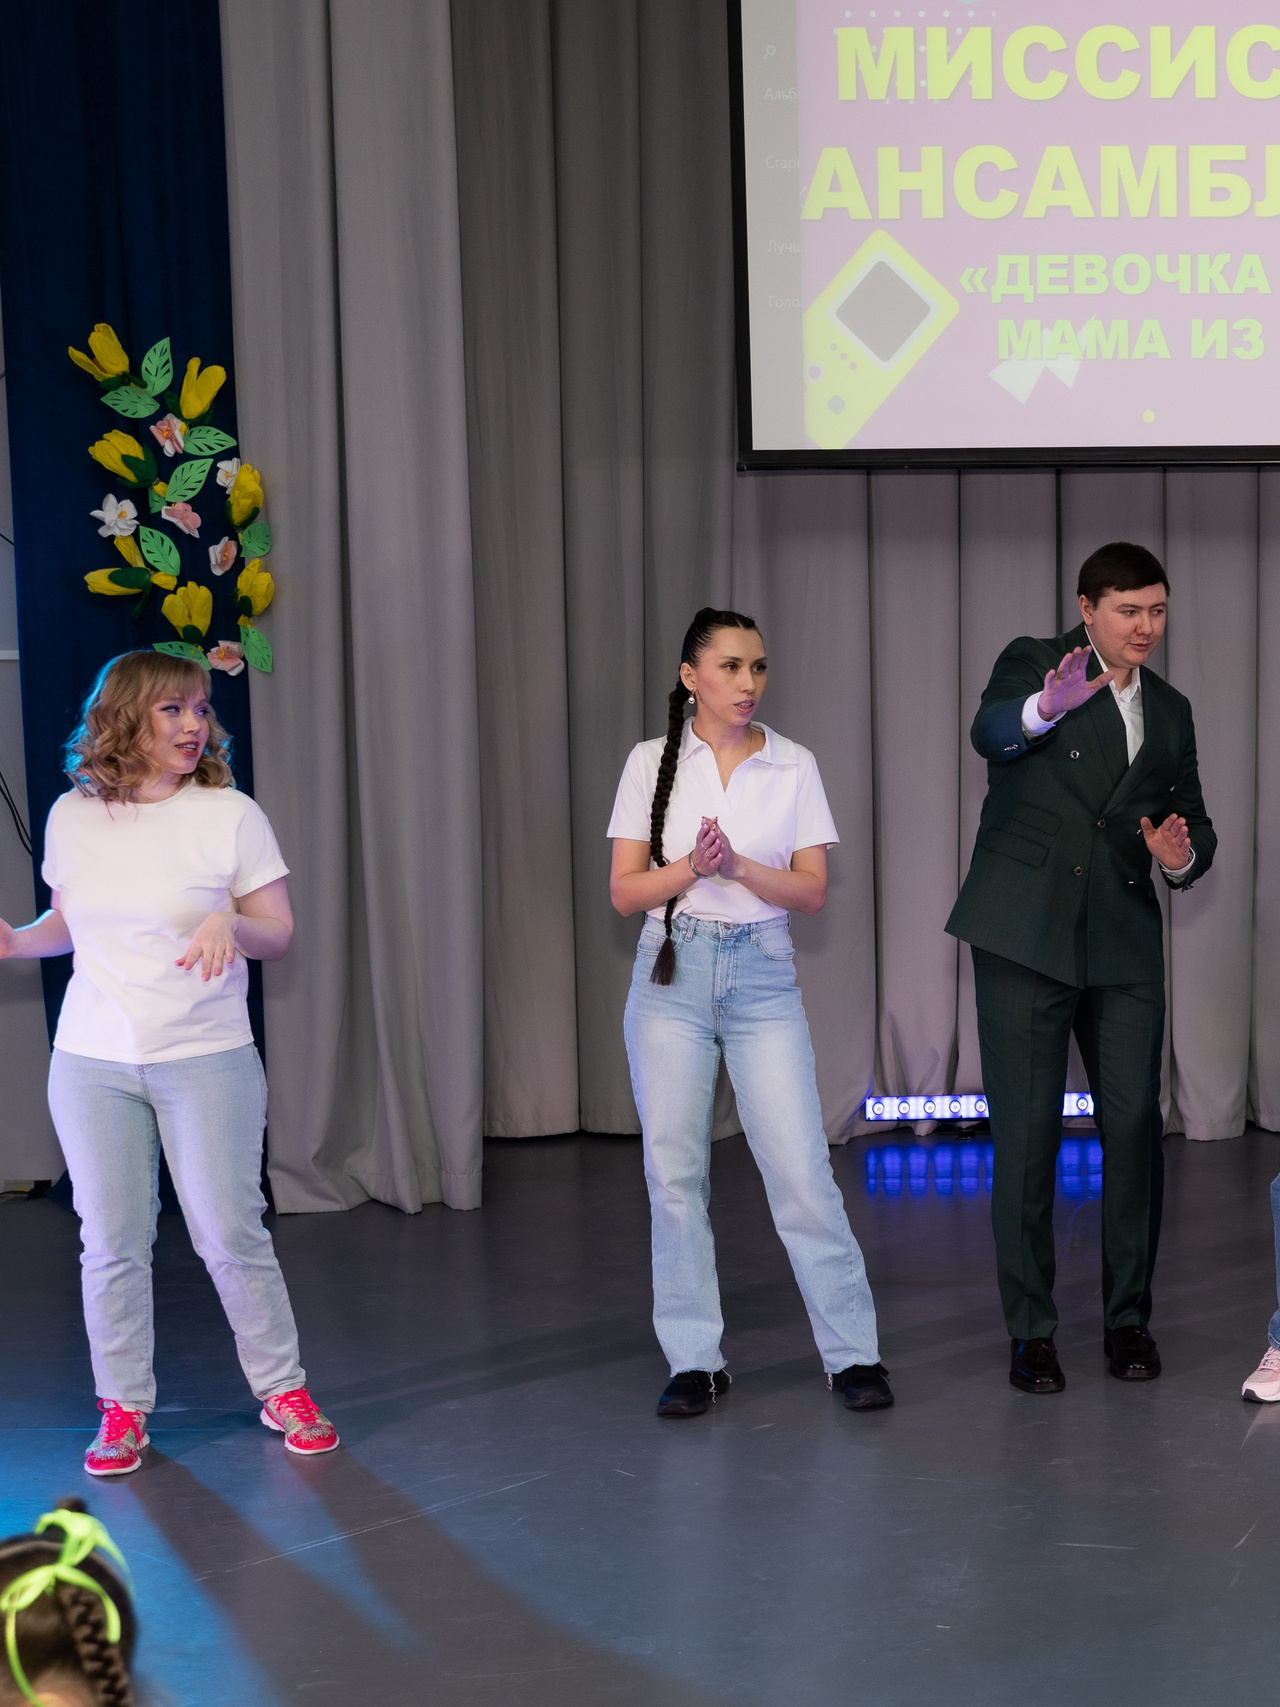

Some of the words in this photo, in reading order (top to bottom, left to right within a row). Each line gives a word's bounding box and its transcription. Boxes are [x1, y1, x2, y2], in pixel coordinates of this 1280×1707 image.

[959, 253, 1272, 304] «ДЕВОЧКА
[997, 318, 1172, 361] МАМА
[1190, 317, 1266, 361] ИЗ
